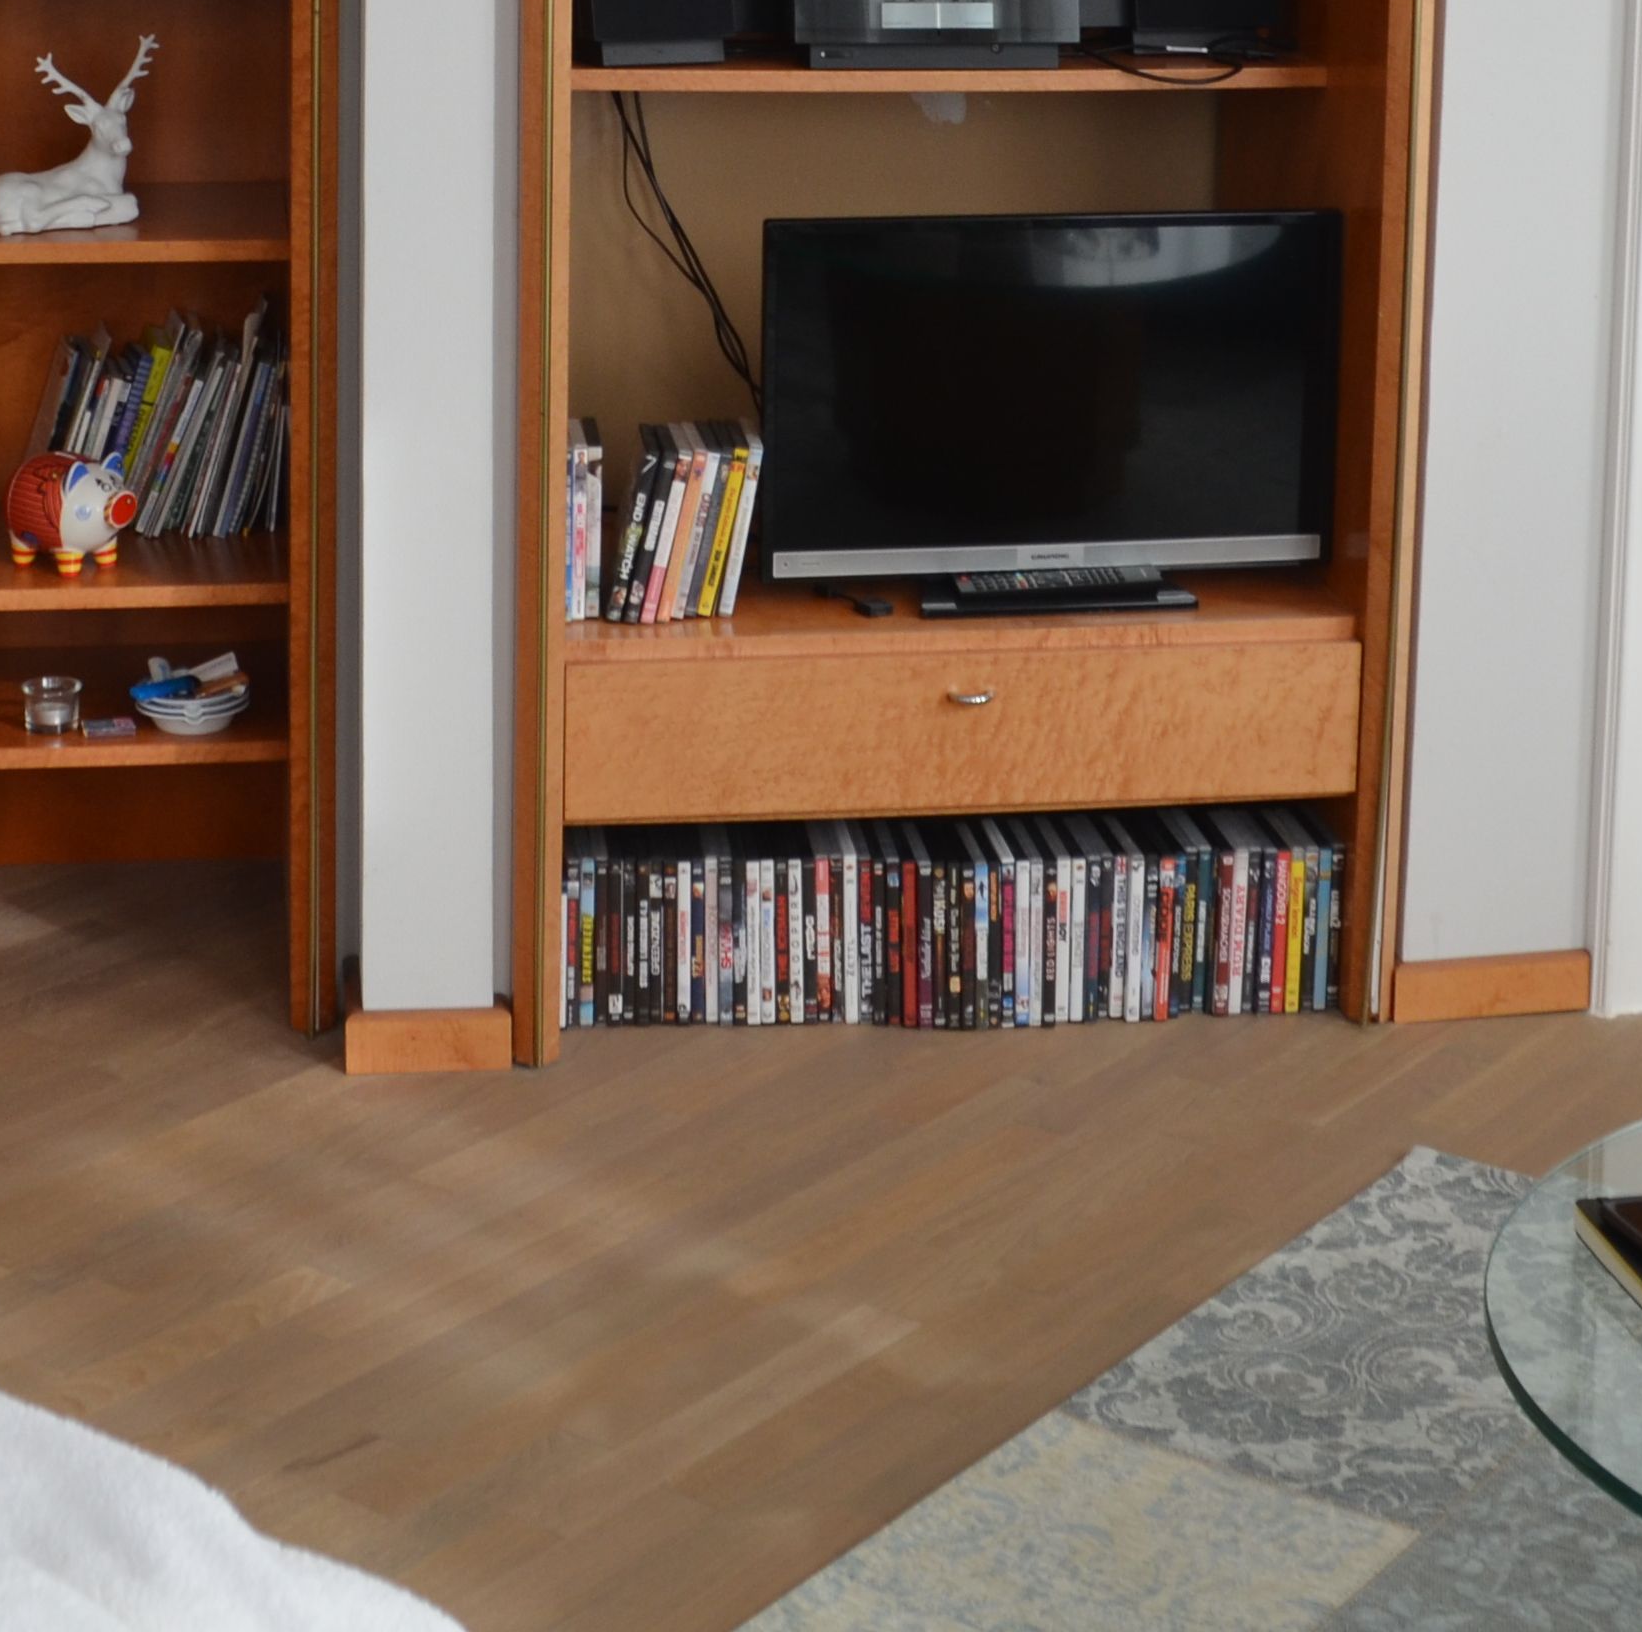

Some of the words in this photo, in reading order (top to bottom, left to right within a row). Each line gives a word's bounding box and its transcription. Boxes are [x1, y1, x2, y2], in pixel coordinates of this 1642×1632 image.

[632, 492, 647, 522] END
[620, 526, 642, 581] WATCH
[1116, 877, 1126, 906] THIS
[1183, 882, 1196, 922] PARIS
[1234, 884, 1245, 936] DIARY
[790, 901, 800, 977] LOOPER
[860, 923, 871, 966] LAST
[1046, 916, 1055, 958] LIGHTS
[1114, 921, 1124, 977] ENGLAND
[1181, 922, 1195, 981] EXPRESS
[1232, 938, 1244, 976] RUM
[860, 967, 871, 998] THE
[1046, 959, 1055, 981] RED
